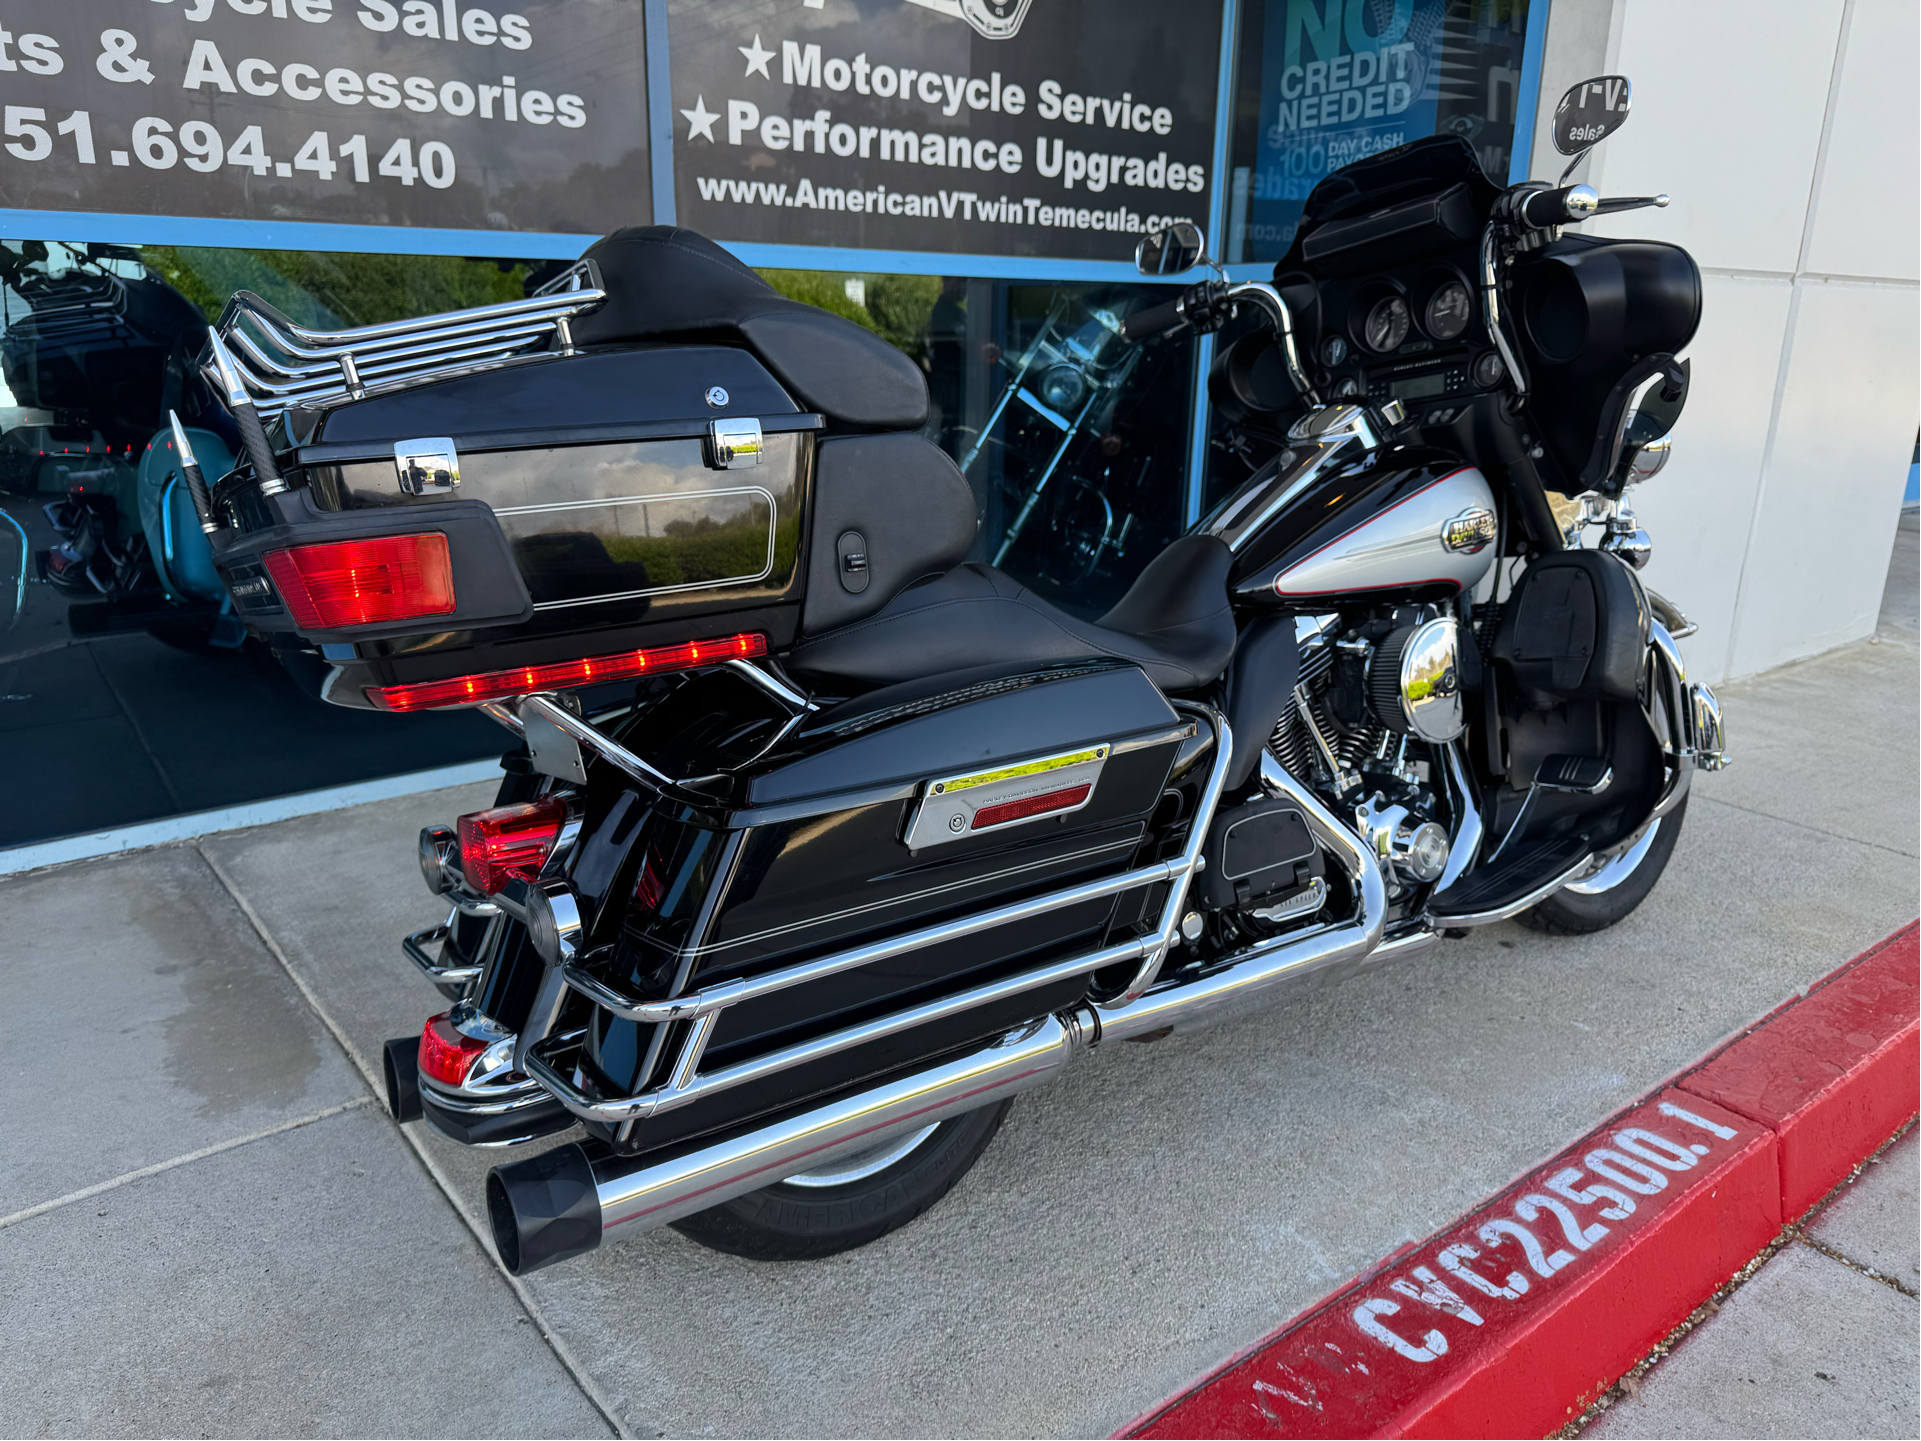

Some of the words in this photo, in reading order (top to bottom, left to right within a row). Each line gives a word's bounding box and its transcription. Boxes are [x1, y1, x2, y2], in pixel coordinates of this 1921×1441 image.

[357, 0, 532, 50] Sales
[1284, 0, 1414, 69] NO
[96, 29, 155, 85] &
[182, 39, 587, 129] Accessories
[782, 40, 1026, 117] Motorcycle
[1037, 80, 1173, 135] Service
[1281, 42, 1415, 100] CREDIT
[1278, 82, 1411, 133] NEEDED
[4, 106, 457, 190] 51.694.4140
[727, 99, 1023, 174] Performance
[1035, 137, 1205, 193] Upgrades
[1279, 144, 1326, 178] 100
[1328, 140, 1358, 157] DAY
[1361, 132, 1405, 151] CASH
